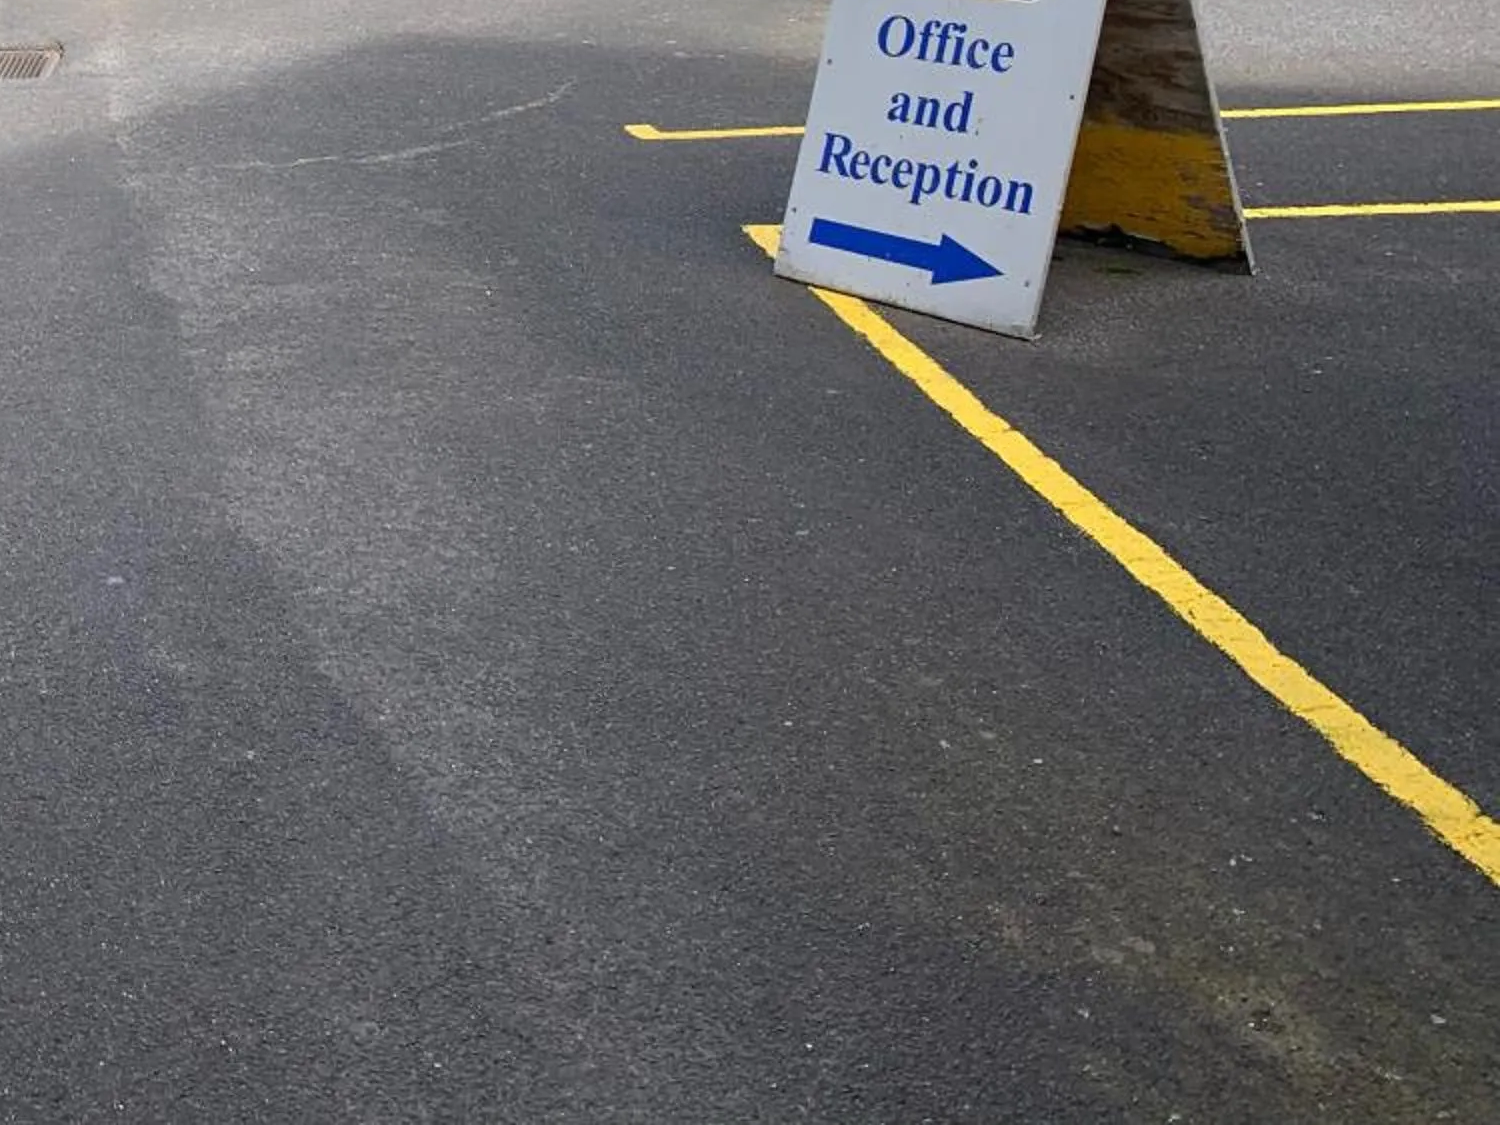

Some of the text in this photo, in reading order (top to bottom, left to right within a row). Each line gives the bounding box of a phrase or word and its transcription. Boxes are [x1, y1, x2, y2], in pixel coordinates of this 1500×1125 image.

[877, 15, 1014, 73] Office
[887, 90, 974, 134] and
[816, 132, 1034, 214] Reception
